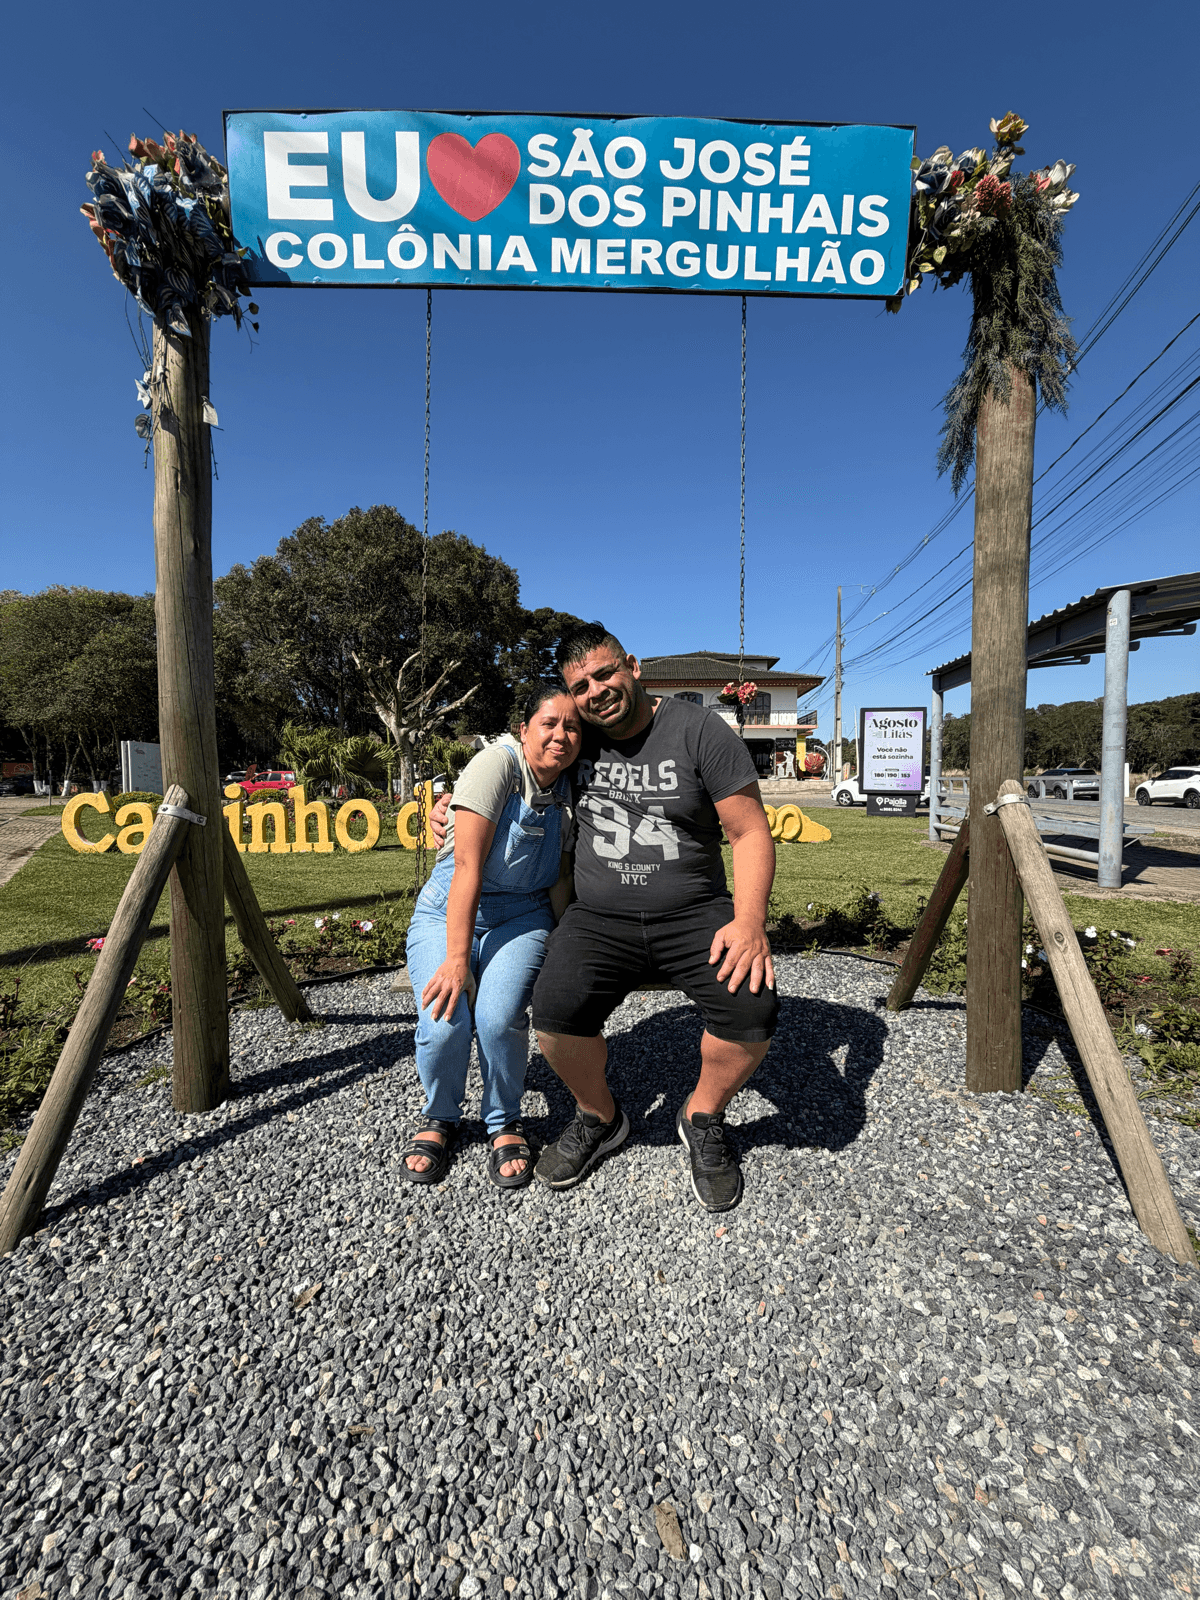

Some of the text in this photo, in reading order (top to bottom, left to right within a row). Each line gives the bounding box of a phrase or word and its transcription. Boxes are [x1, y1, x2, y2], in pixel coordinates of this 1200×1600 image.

[263, 131, 421, 222] EU
[527, 127, 811, 187] SÃO JOSÉ
[528, 183, 890, 238] DOS PINHAIS
[265, 223, 886, 286] COLÔNIA MERGULHÃO
[869, 717, 918, 730] Agosto
[883, 728, 913, 739] Lilás
[576, 758, 679, 792] REBELS
[61, 782, 382, 854] Cainho
[620, 873, 648, 886] NYC
[631, 863, 661, 872] COUNTY
